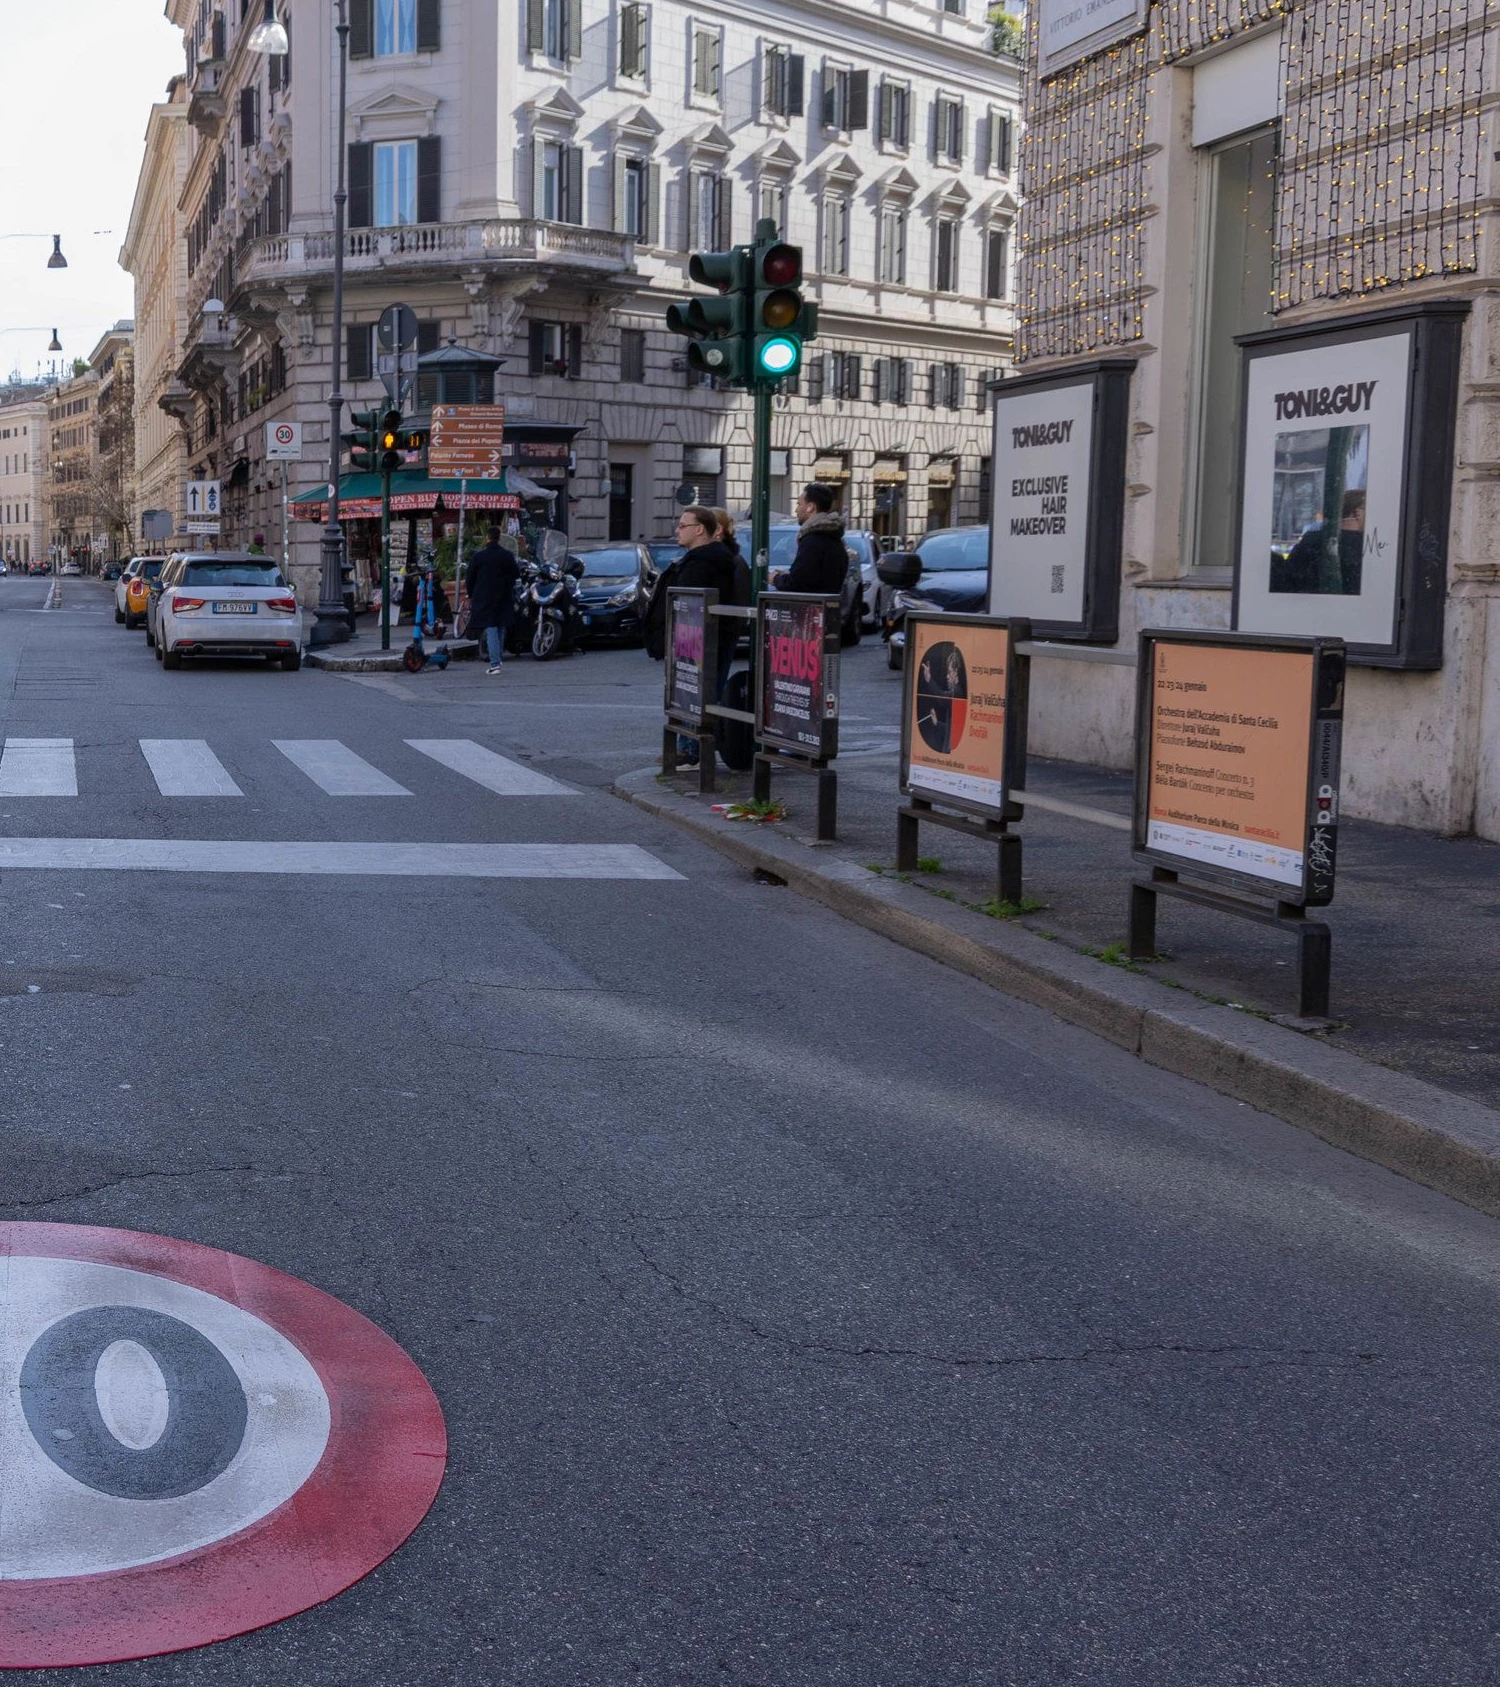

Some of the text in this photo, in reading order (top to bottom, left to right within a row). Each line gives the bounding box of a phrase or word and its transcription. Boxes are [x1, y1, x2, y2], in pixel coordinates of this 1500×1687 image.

[1050, 8, 1082, 34] VITTORIO
[1275, 380, 1379, 421] TONI&GUY
[279, 430, 291, 439] 30
[1012, 419, 1075, 449] TONI&GUY
[1011, 475, 1069, 497] EXCLUSIVE
[420, 494, 439, 502] BUS
[1041, 495, 1067, 515] HAIR
[1010, 517, 1067, 536] MAKEOVER
[769, 634, 820, 681] VENUS
[1166, 681, 1174, 691] 23
[1184, 681, 1207, 692] gennaio
[1157, 705, 1278, 729] Orchestra dell'Accademia di Santa Cecilia
[1182, 722, 1196, 735] Juraj
[1186, 737, 1208, 750] Behzod
[1156, 760, 1174, 774] Sergej
[1175, 763, 1214, 779] Rachmaninoff
[1215, 769, 1242, 784] Concerto
[1249, 777, 1255, 788] 3
[1155, 774, 1255, 801] Béla Bartók Concerto per orchestra
[1168, 809, 1193, 822] Auditorium
[1194, 814, 1207, 825] Parco
[1208, 816, 1221, 828] della
[1221, 819, 1239, 832] Musica
